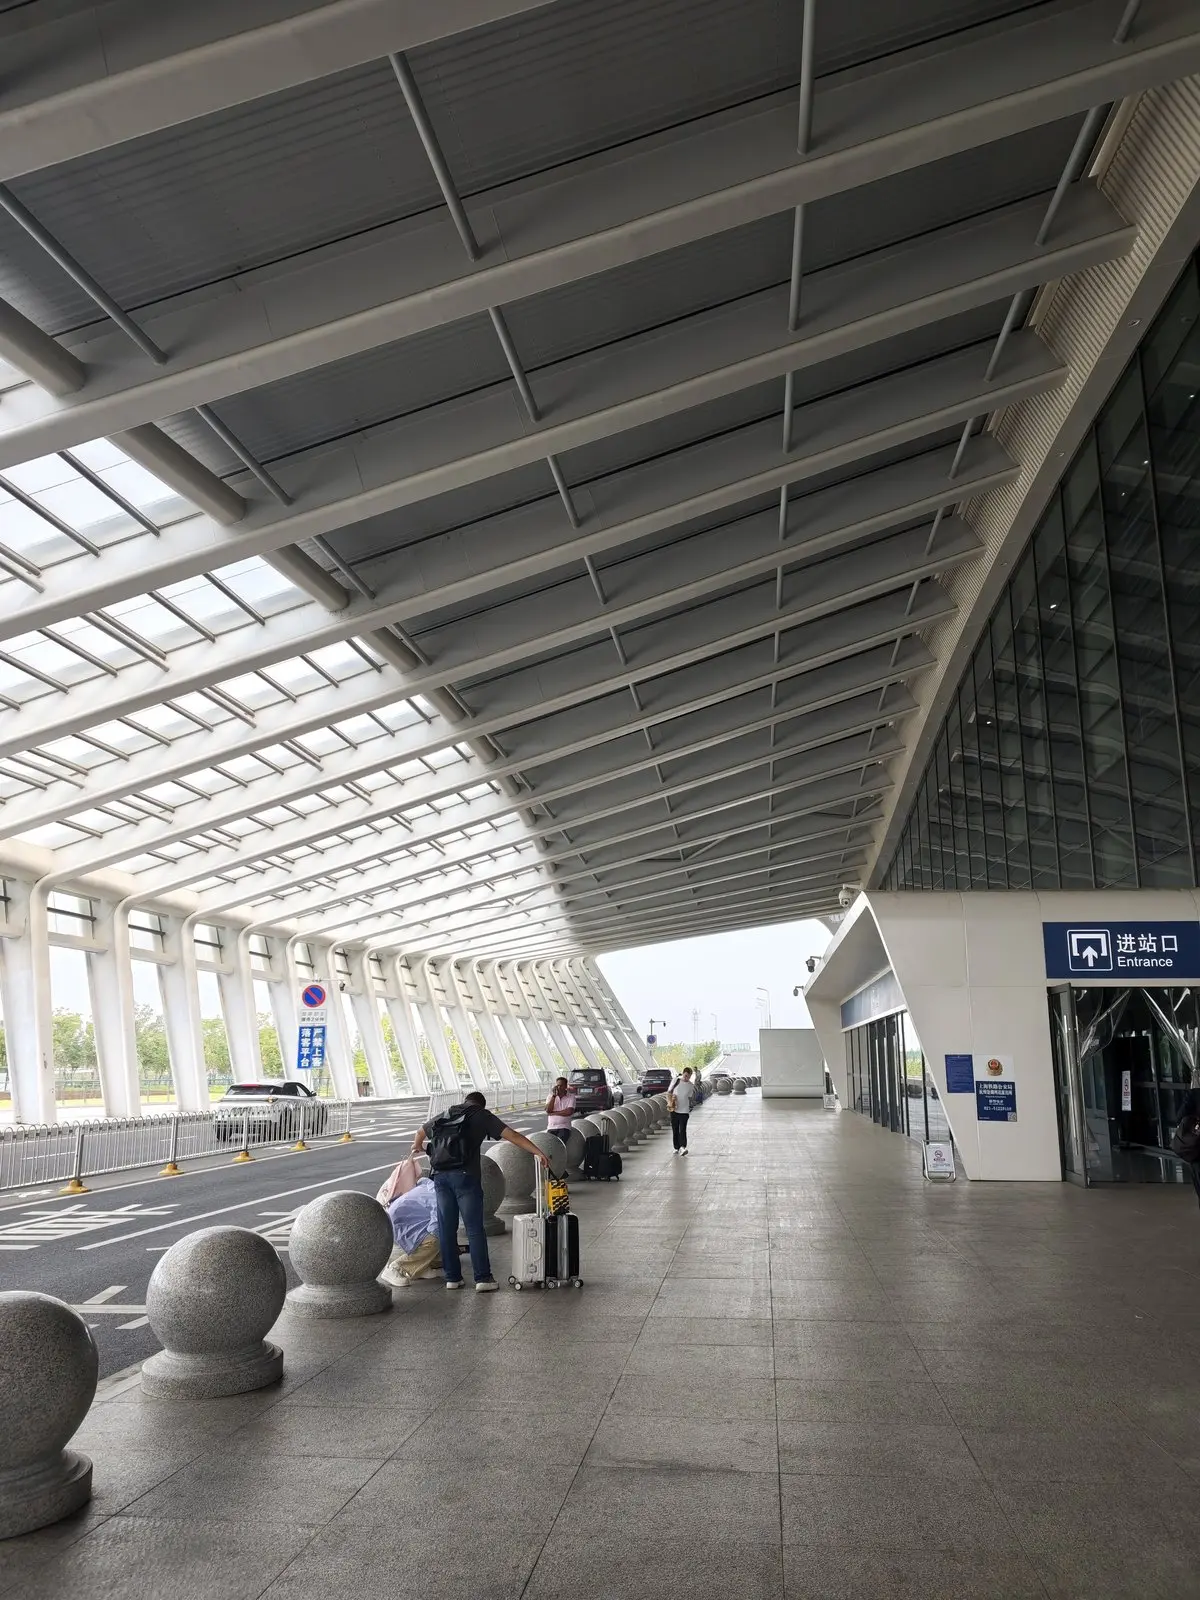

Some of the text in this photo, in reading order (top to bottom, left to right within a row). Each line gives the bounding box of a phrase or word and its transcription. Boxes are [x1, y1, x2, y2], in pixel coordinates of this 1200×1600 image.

[1116, 932, 1179, 953] 进站口
[1117, 956, 1174, 967] Entrance
[301, 1028, 311, 1067] 落客平台
[312, 1028, 323, 1067] 严禁上客
